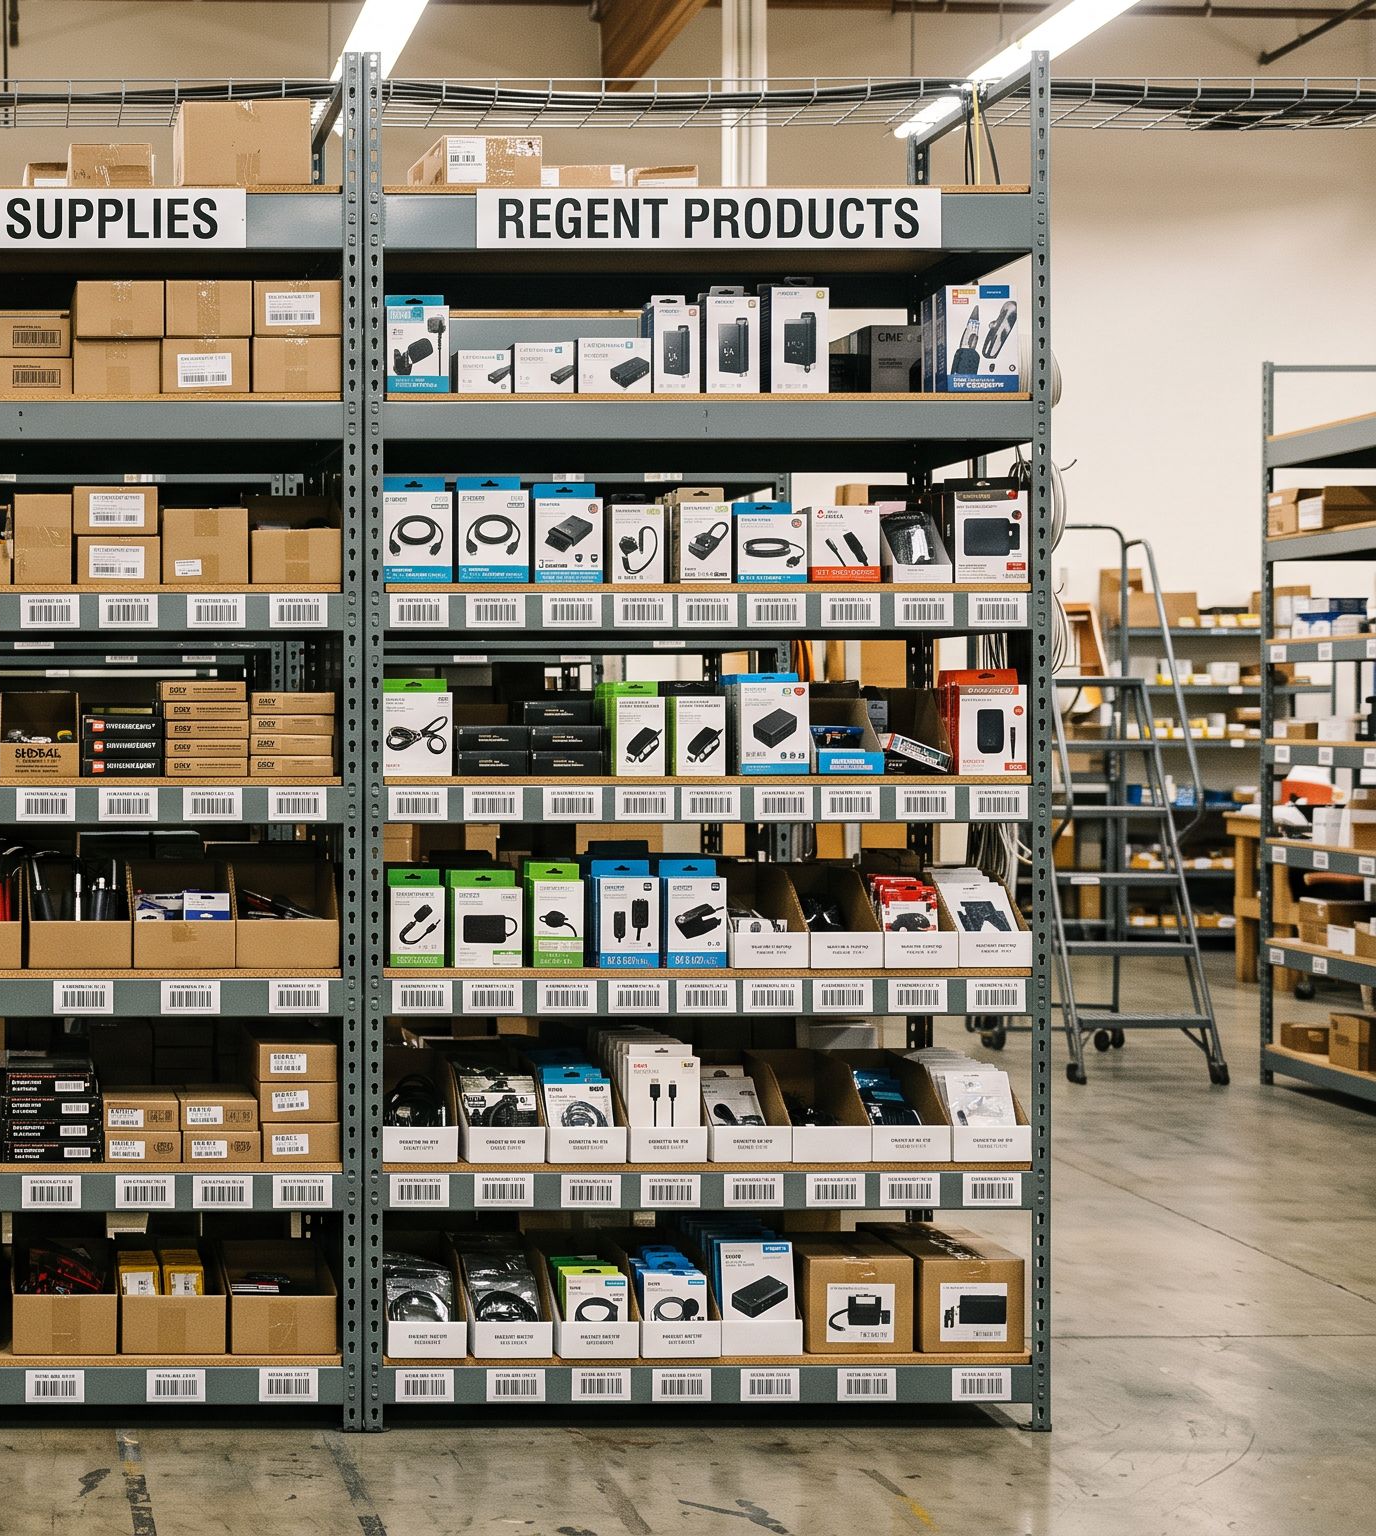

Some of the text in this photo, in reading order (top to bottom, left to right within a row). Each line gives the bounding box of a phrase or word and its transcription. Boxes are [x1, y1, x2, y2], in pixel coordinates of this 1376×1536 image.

[7, 198, 218, 240] SUPPLIES
[498, 198, 920, 240] REGENT PRODUCTS
